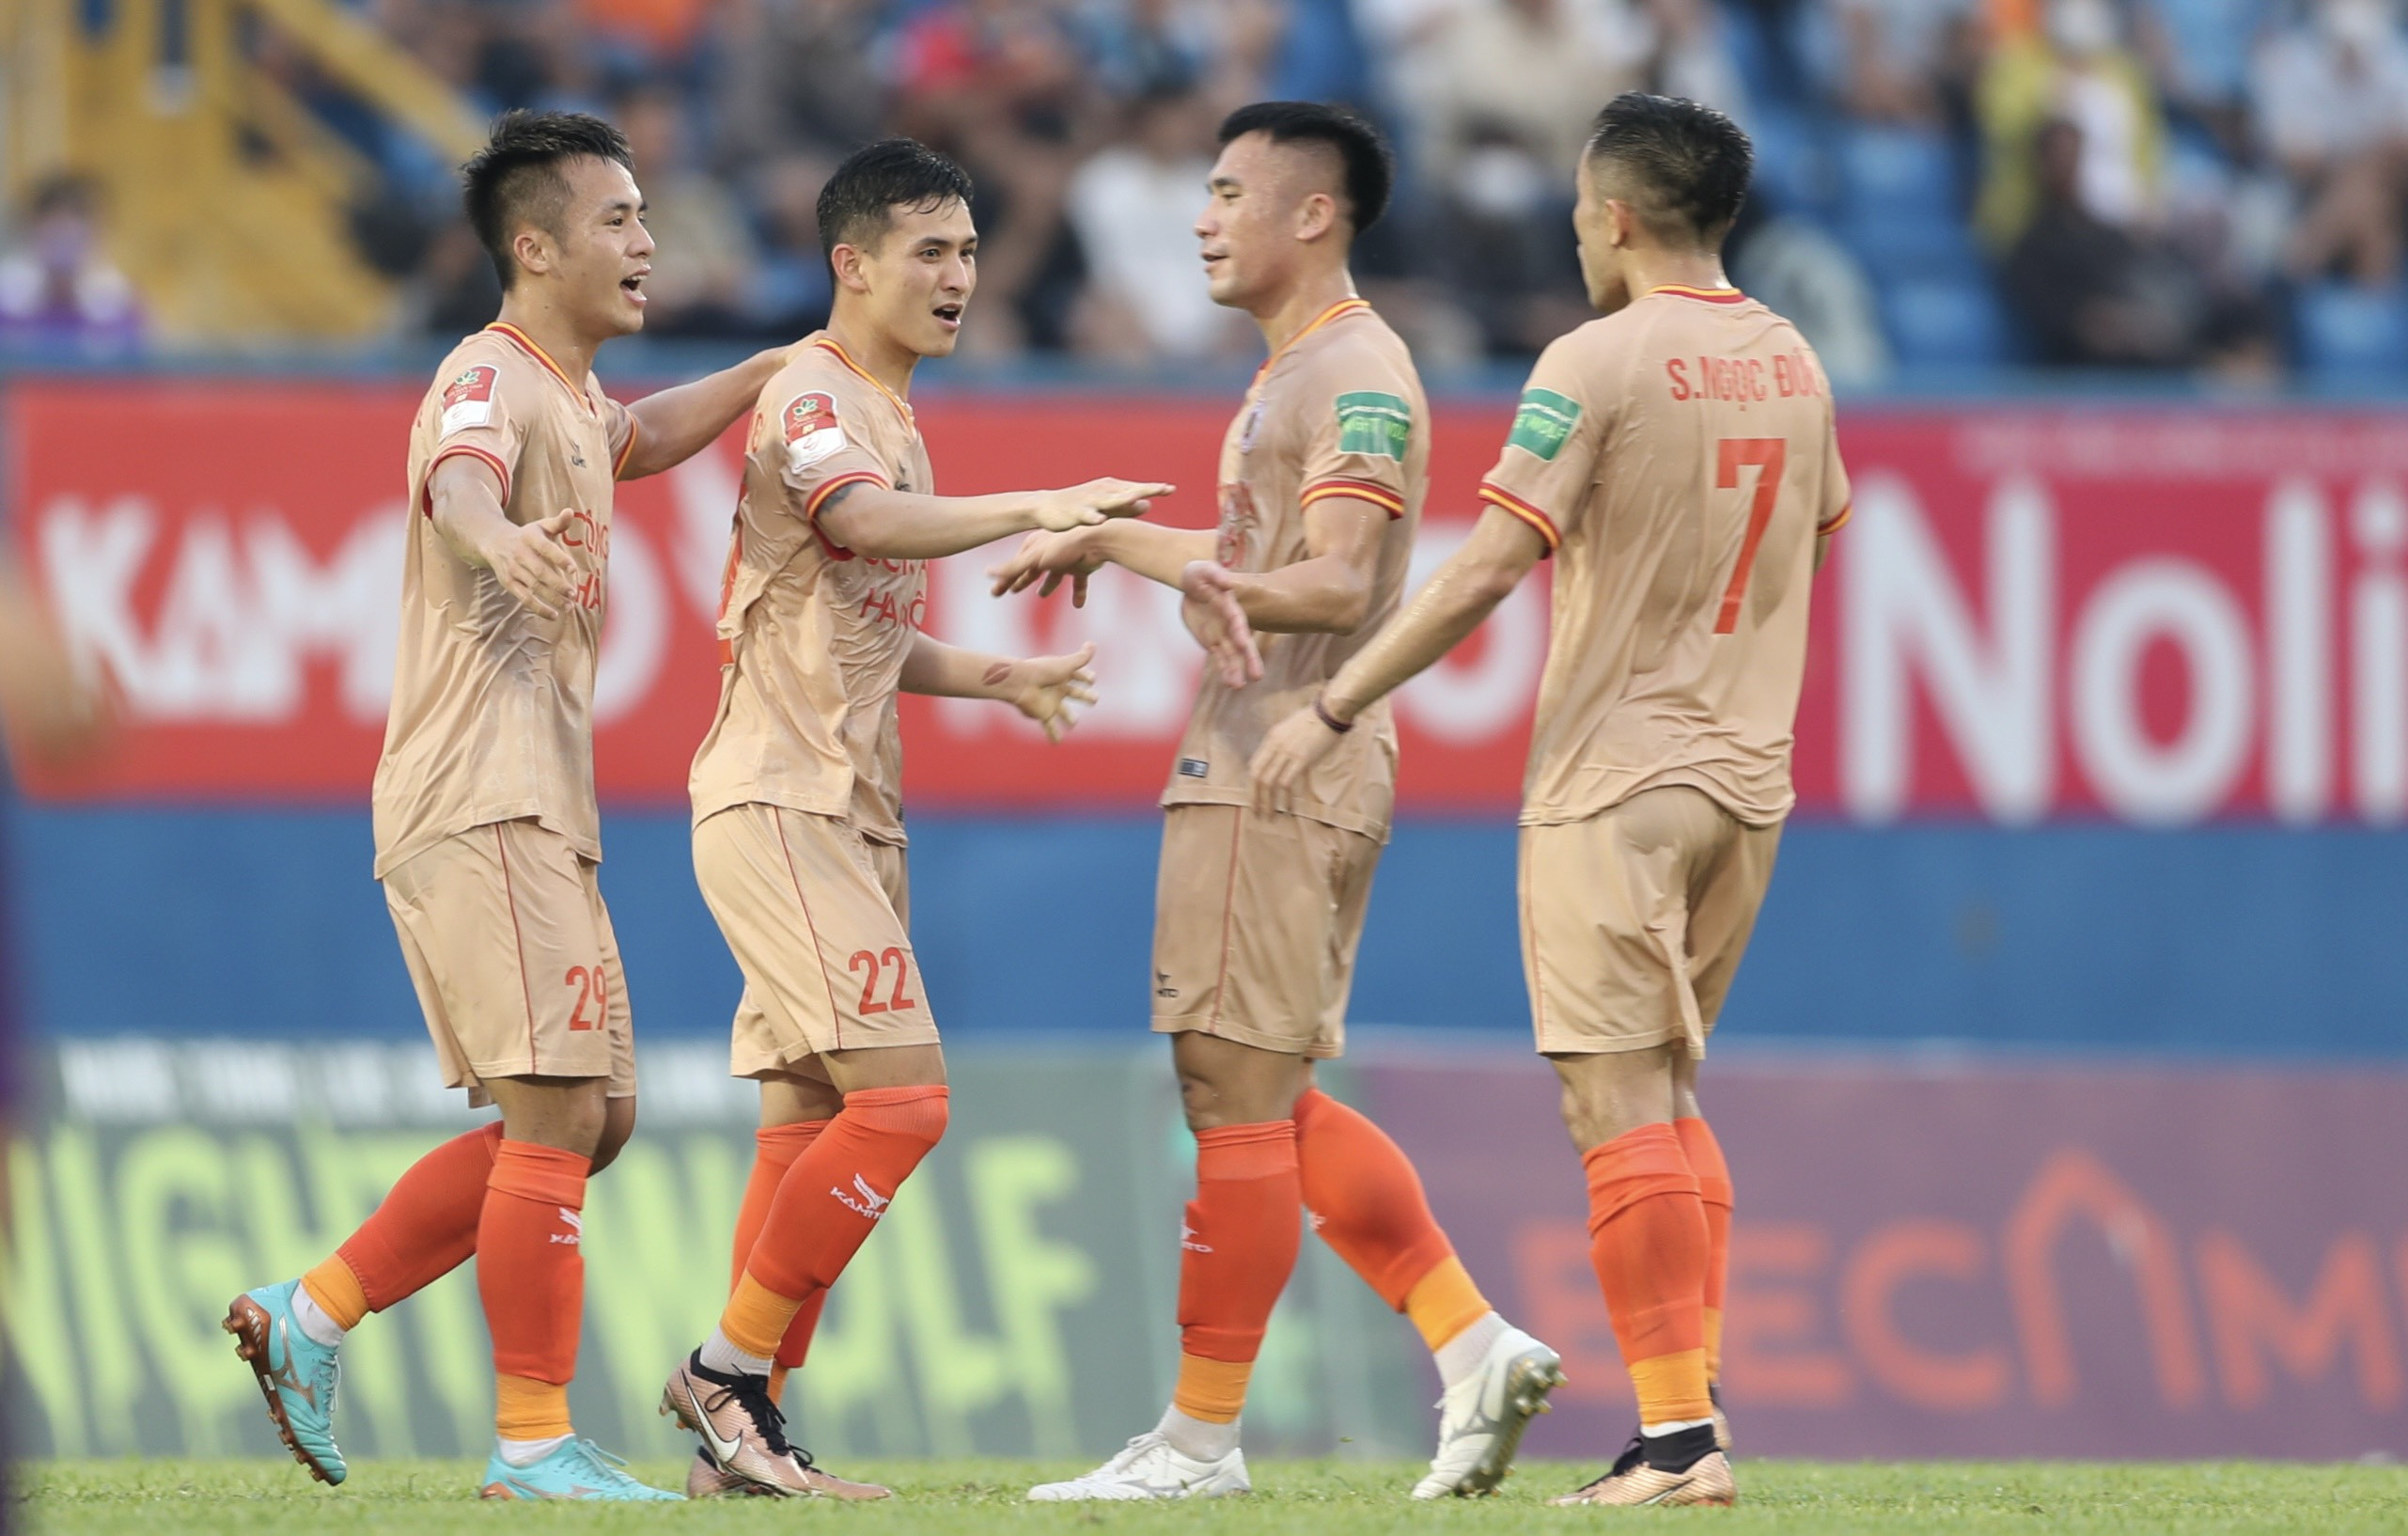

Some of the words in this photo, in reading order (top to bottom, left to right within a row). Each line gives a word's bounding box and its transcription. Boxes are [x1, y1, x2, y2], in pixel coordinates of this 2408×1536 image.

[1712, 438, 1786, 634] 7
[565, 965, 609, 1030] 29
[849, 947, 915, 1015] 22
[830, 1186, 882, 1220] KAMIT
